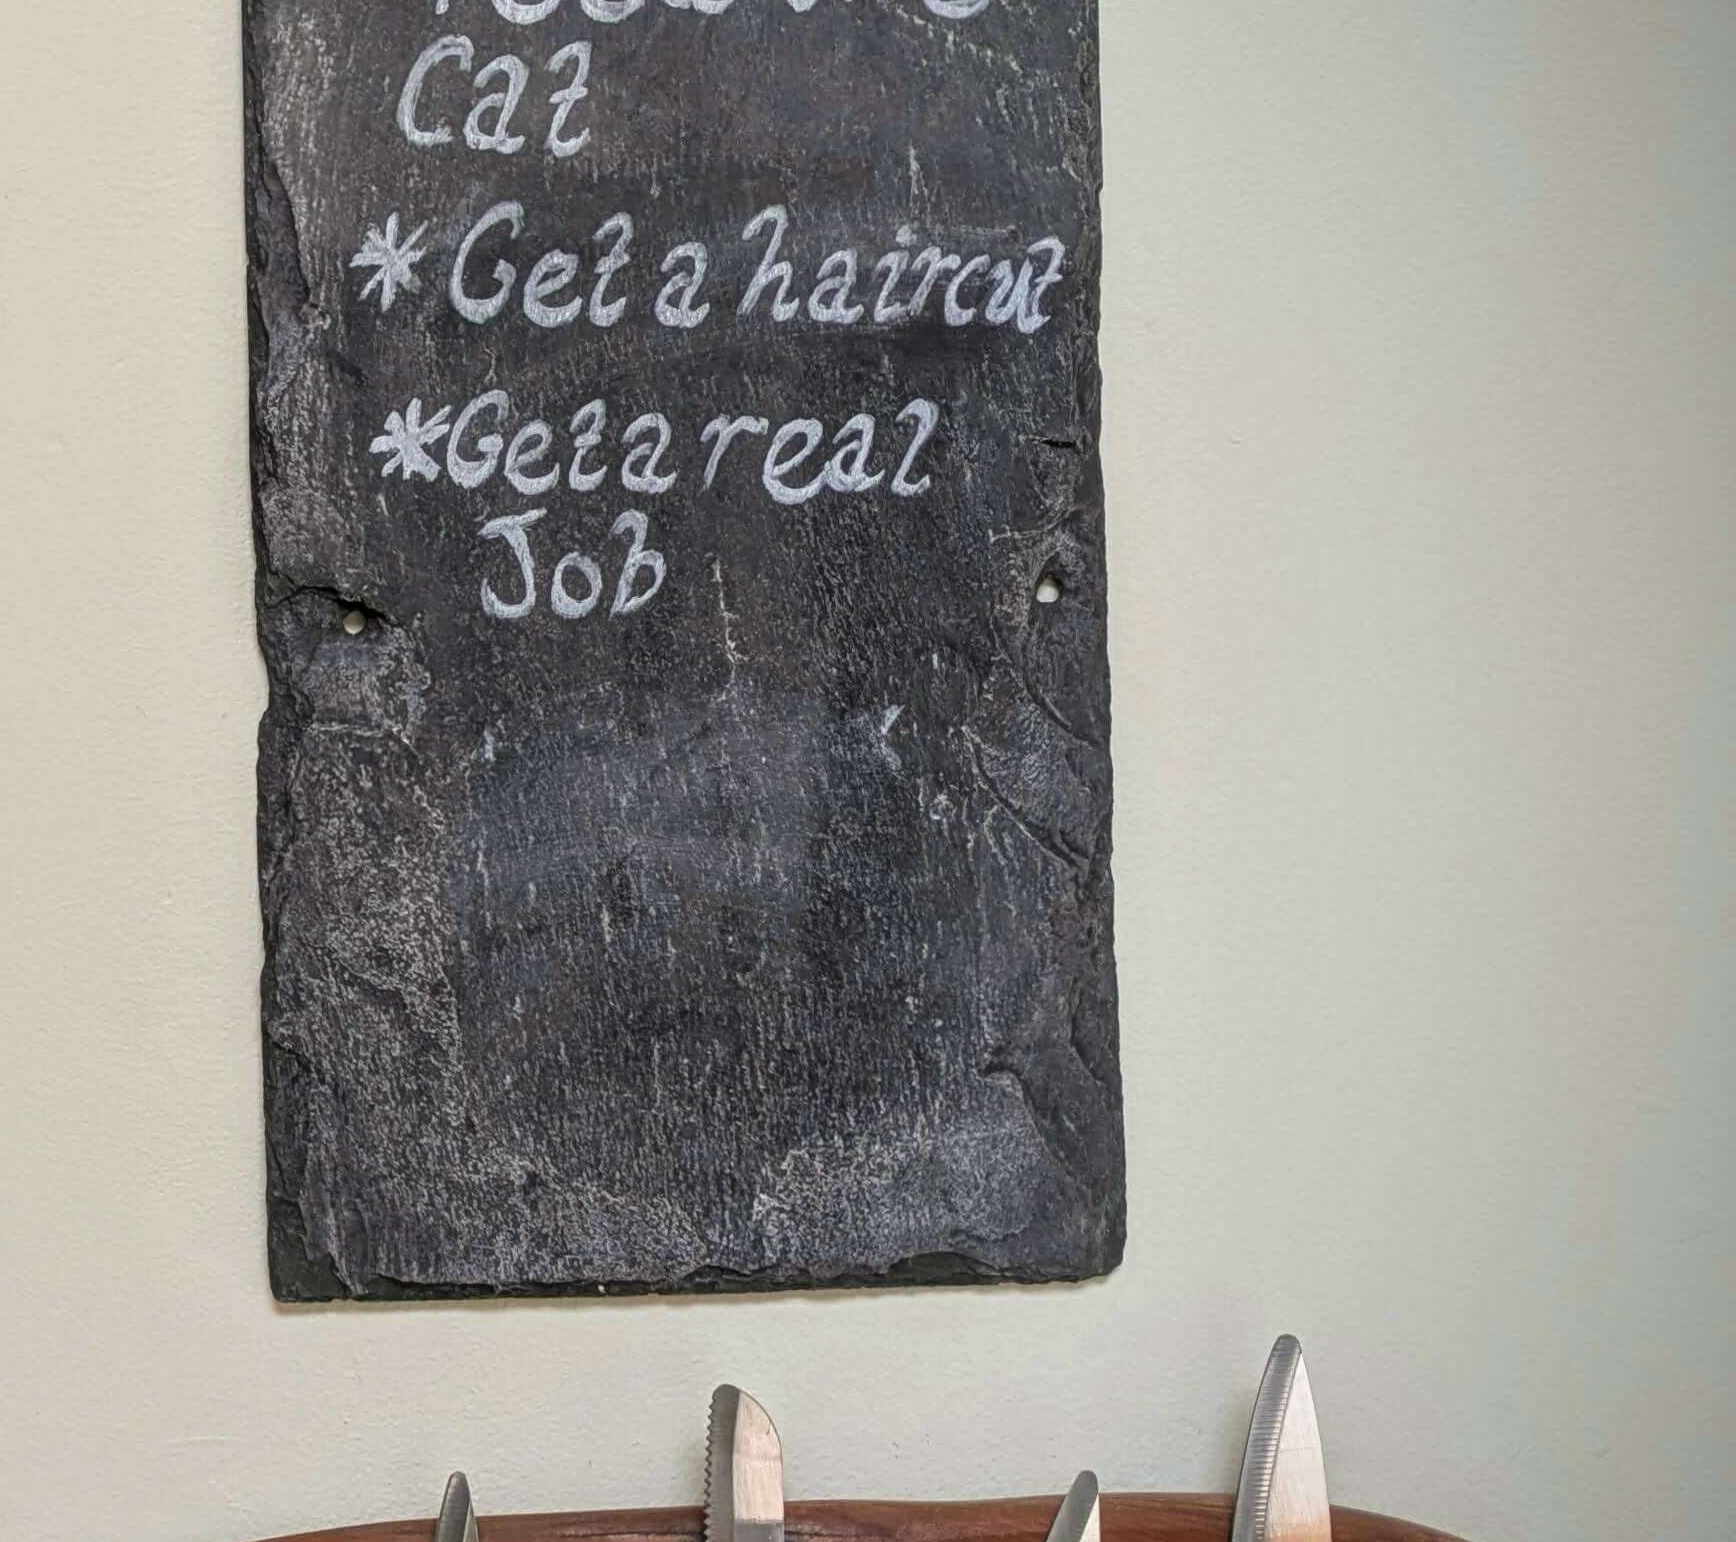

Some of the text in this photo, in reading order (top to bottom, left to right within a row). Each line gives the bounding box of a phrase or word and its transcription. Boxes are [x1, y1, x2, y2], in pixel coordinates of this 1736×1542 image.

[394, 33, 594, 157] Cat
[737, 204, 1065, 334] haircut
[699, 397, 944, 505] real
[479, 507, 666, 620] Job
